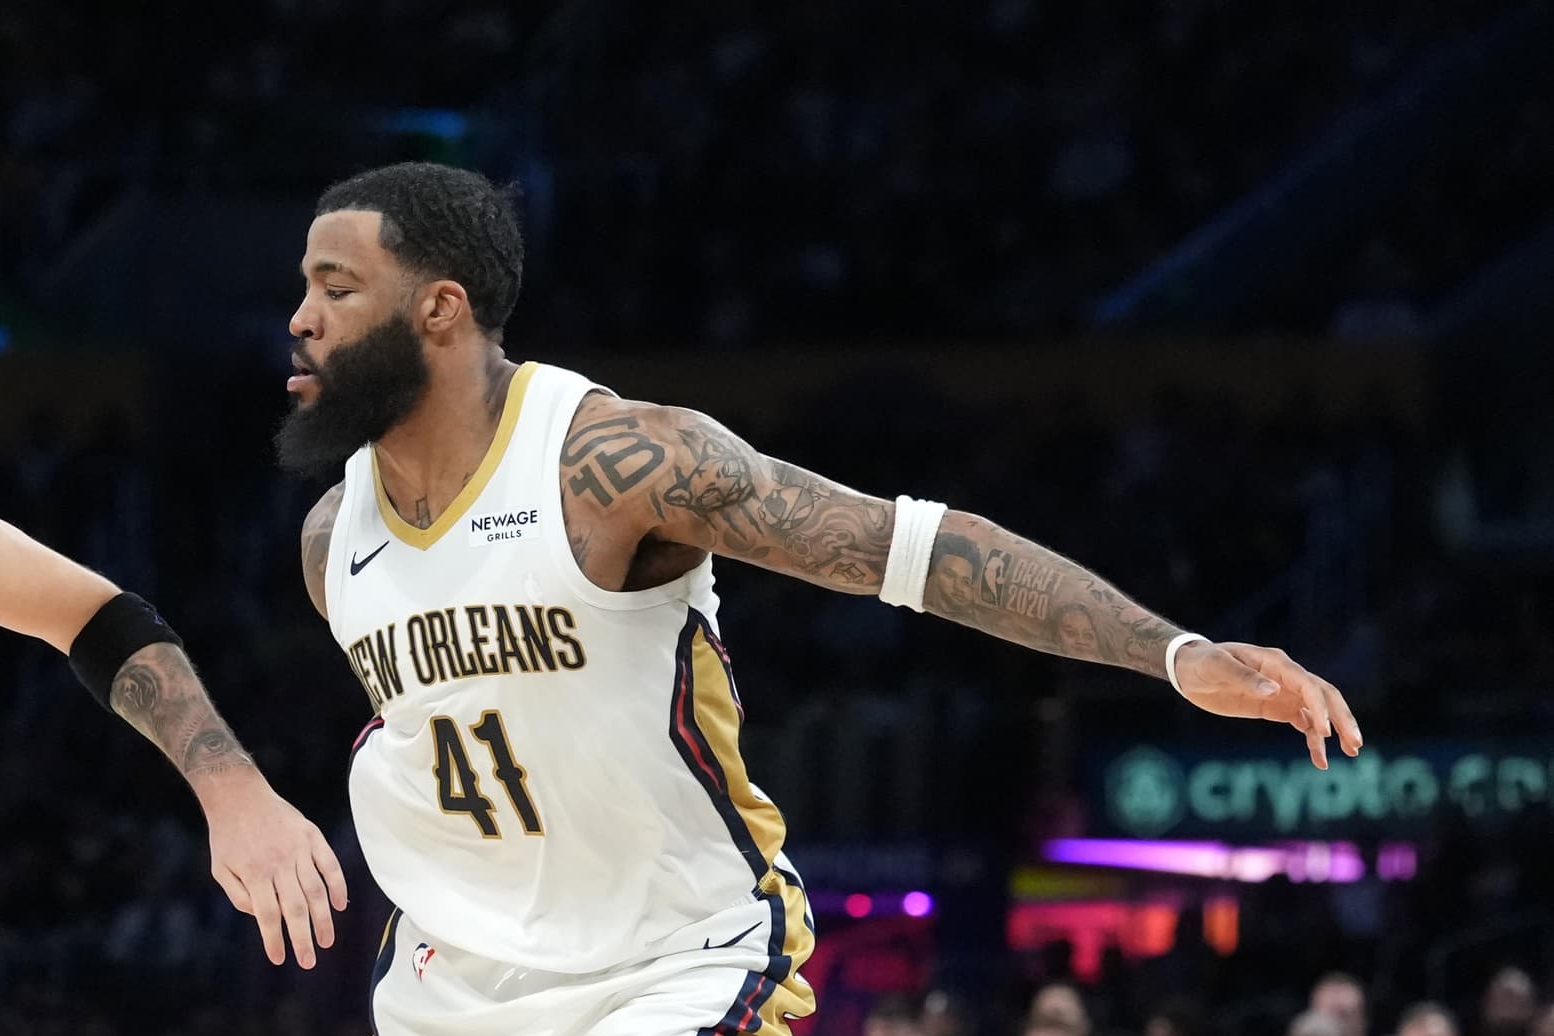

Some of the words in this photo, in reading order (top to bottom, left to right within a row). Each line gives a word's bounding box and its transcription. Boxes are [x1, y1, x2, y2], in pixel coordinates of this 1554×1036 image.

[471, 509, 538, 532] NEWAGE
[487, 529, 522, 542] GRILLS
[1006, 584, 1048, 621] 2020
[407, 604, 587, 686] ORLEANS
[430, 709, 545, 840] 41
